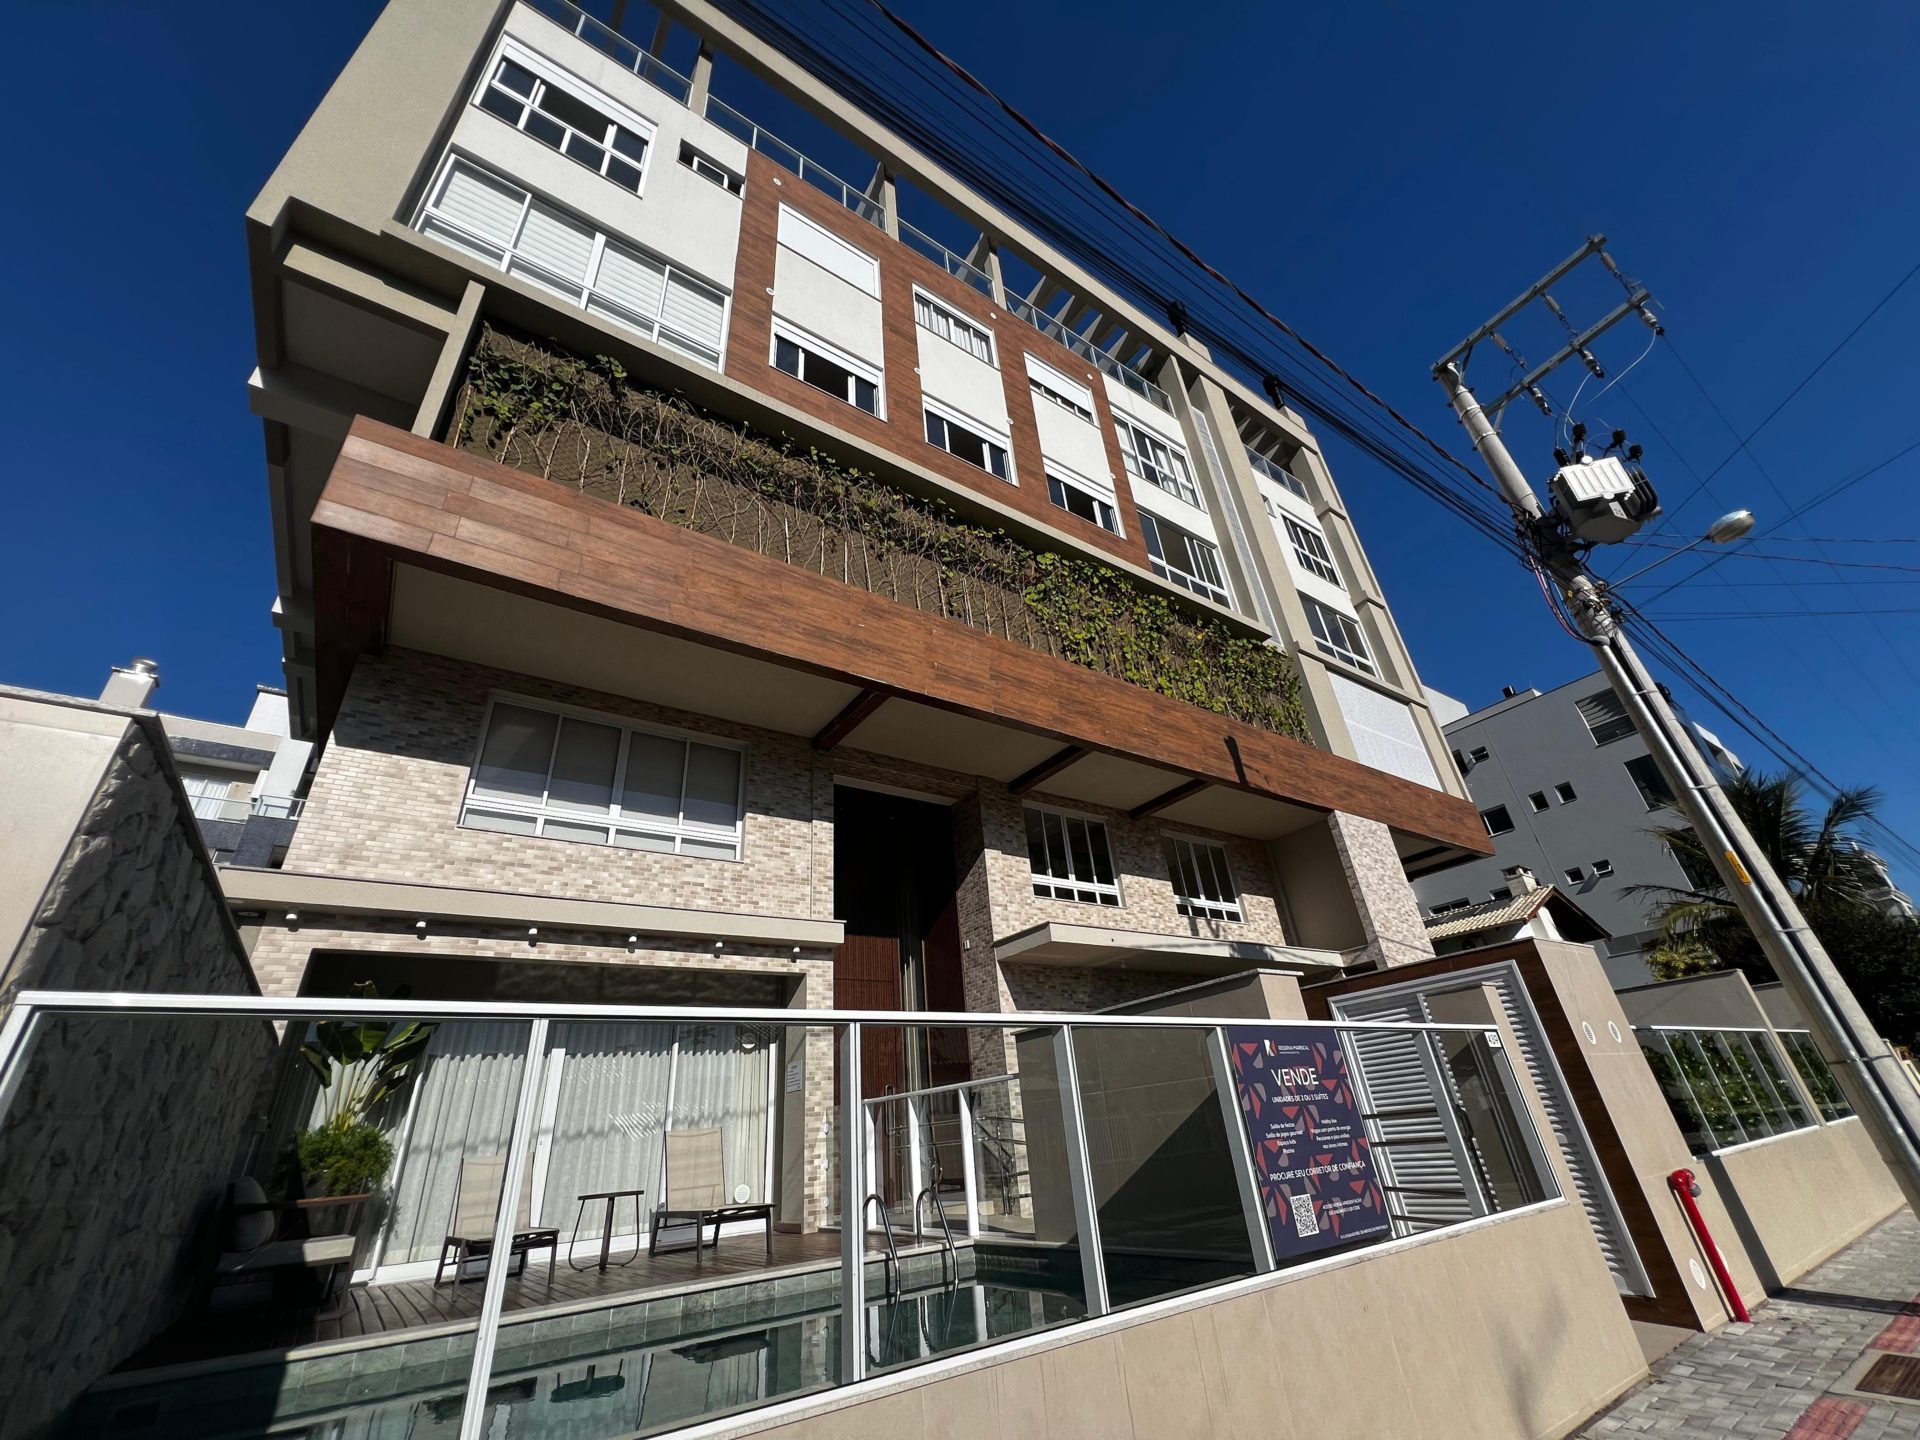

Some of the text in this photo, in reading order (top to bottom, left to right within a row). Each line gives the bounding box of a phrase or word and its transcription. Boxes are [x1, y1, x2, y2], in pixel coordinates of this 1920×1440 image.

[1271, 1068, 1319, 1086] VENDE
[1270, 1171, 1295, 1181] PROCURE
[1295, 1170, 1306, 1178] SEU
[1306, 1166, 1332, 1177] CORRETOR
[1339, 1160, 1366, 1171] CONFIANÇA
